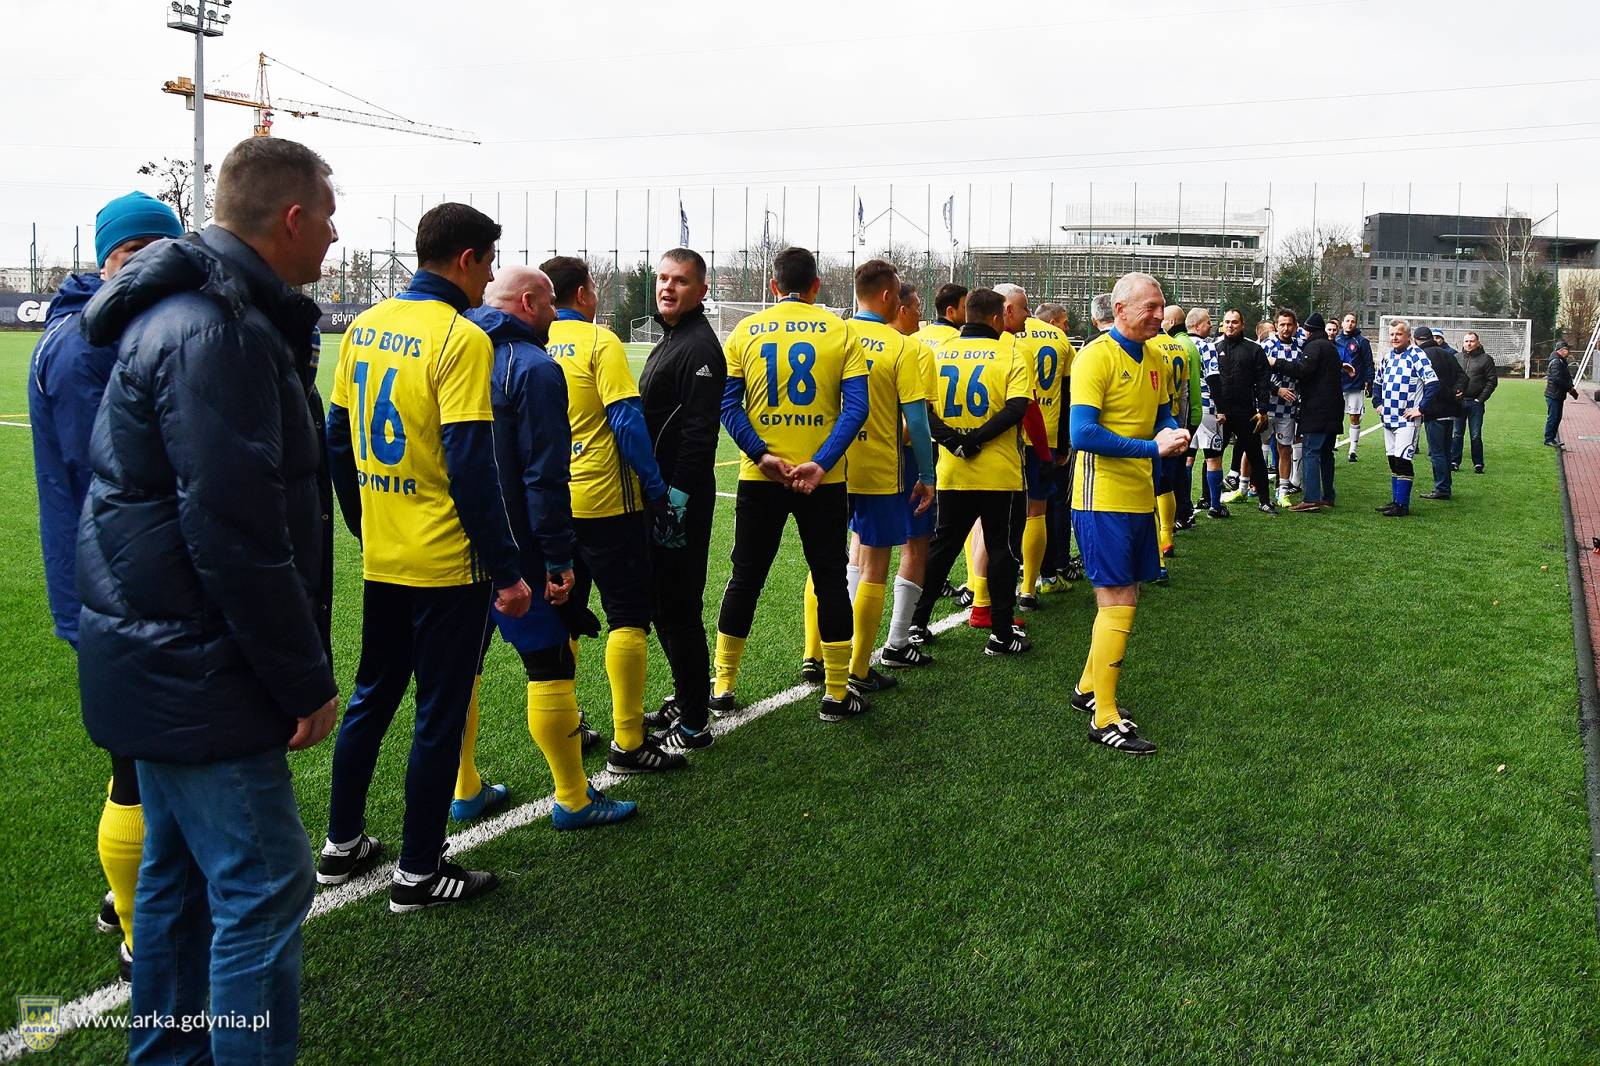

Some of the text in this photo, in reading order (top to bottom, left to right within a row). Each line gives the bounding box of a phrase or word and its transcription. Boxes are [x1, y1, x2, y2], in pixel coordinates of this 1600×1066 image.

[331, 311, 359, 326] gdyni
[750, 321, 827, 335] OLD BOYS
[1015, 330, 1059, 340] LD BOYS
[351, 327, 422, 358] OLD BOYS
[860, 337, 885, 352] OYS
[546, 343, 575, 359] OYS
[937, 350, 996, 360] OLD BOYS
[760, 341, 817, 407] 18
[1037, 345, 1058, 391] 0
[940, 365, 990, 418] 26
[353, 361, 407, 466] 16
[760, 414, 824, 427] GDYNIA
[357, 469, 417, 496] DNIA
